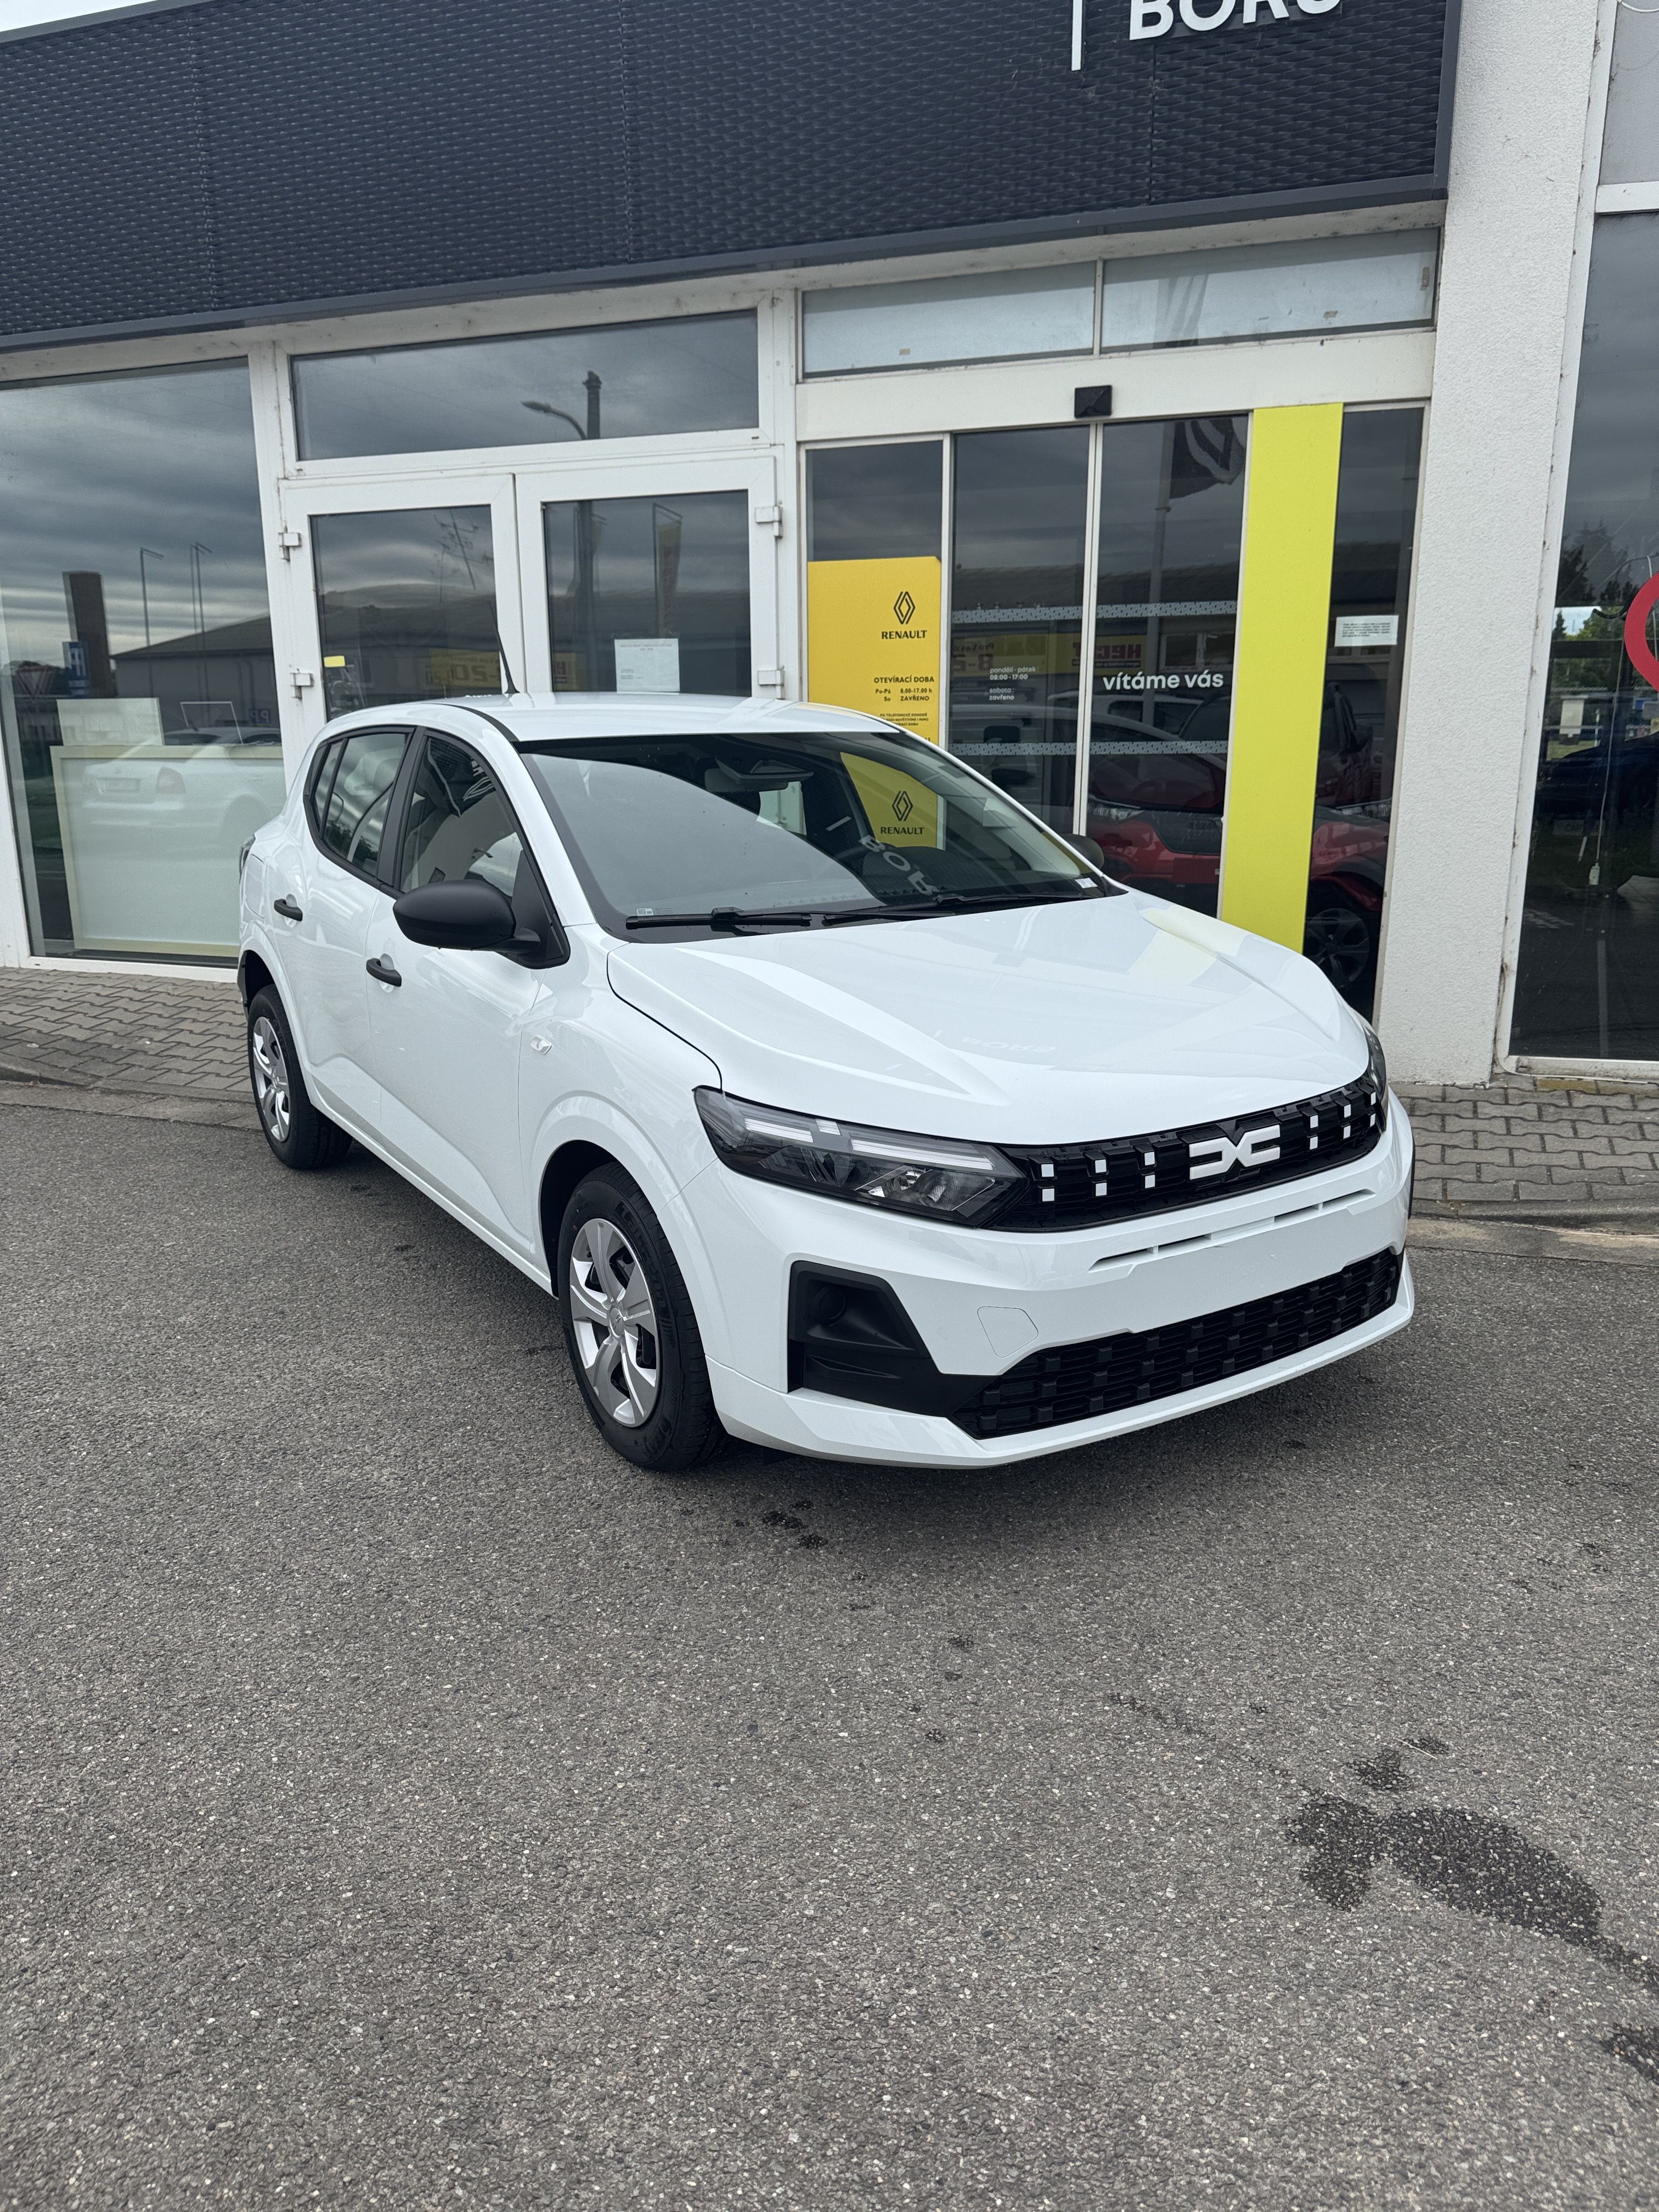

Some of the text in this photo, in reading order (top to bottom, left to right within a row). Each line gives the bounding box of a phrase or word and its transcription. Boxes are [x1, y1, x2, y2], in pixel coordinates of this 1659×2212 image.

[1130, 0, 1342, 40] BO
[881, 630, 927, 639] RENAULT
[1103, 669, 1224, 690] vítáme vás
